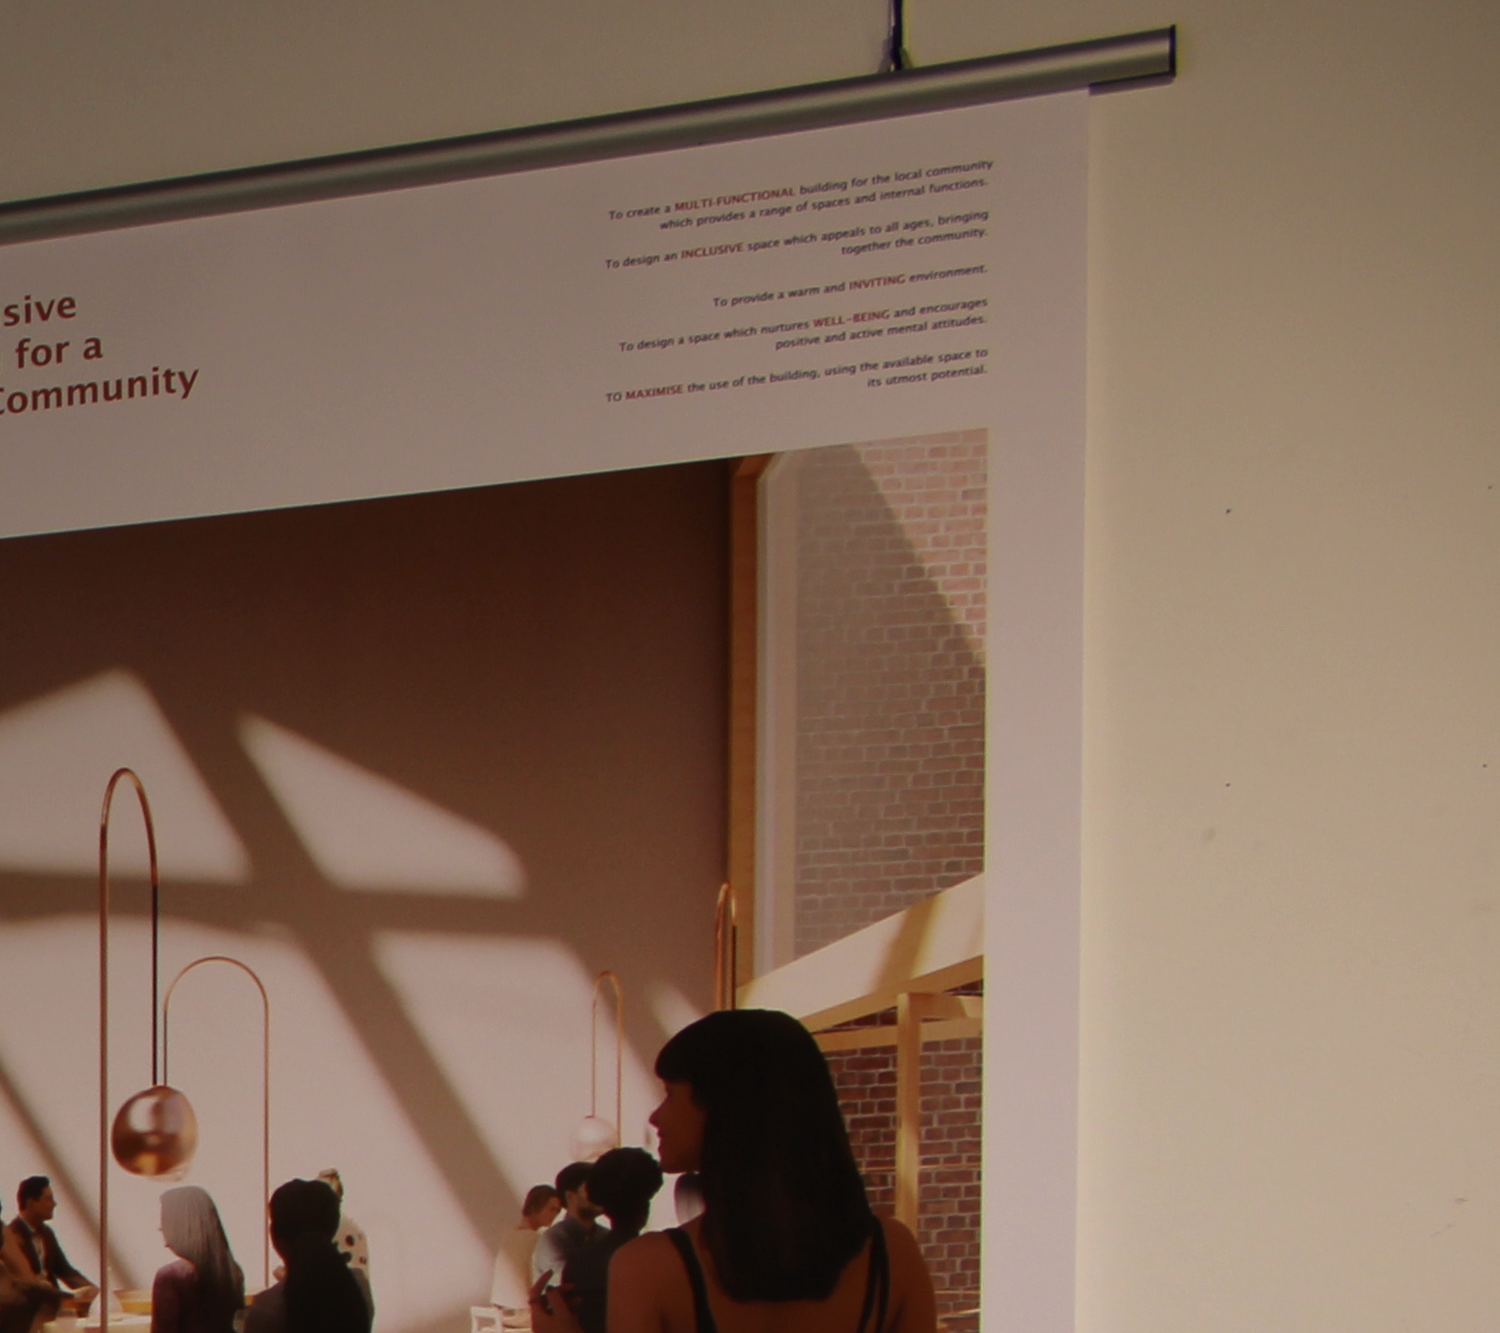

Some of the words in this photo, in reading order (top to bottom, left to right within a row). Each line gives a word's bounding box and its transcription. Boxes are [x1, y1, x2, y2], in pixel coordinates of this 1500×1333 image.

[609, 210, 623, 220] To
[627, 205, 660, 218] create
[665, 204, 671, 213] a
[675, 187, 795, 211] MULTI-FUNCTIONAL
[800, 179, 847, 195] building
[852, 176, 868, 188] for
[872, 173, 890, 185] the
[895, 168, 921, 182] local
[926, 160, 993, 178] community
[606, 259, 620, 269] To
[623, 252, 660, 268] design
[664, 252, 678, 261] an
[681, 242, 743, 259] INCLUSIVE
[747, 239, 780, 253] space
[784, 232, 817, 246] which
[821, 226, 865, 243] appeals
[869, 224, 881, 234] to
[886, 220, 898, 232] all
[902, 219, 933, 232] ages,
[938, 209, 989, 227] bringing
[841, 241, 890, 256] together
[895, 235, 914, 247] the
[918, 227, 988, 246] community.
[713, 297, 727, 307] To
[731, 290, 774, 307] provide
[778, 291, 784, 299] a
[788, 285, 820, 297] warm
[824, 282, 845, 293] and
[850, 274, 905, 291] INVITING
[909, 264, 988, 284] environment.
[776, 334, 820, 350] positive
[824, 331, 846, 344] and
[850, 326, 883, 340] active
[887, 321, 928, 335] mental
[932, 315, 987, 330] attitudes.
[16, 338, 70, 368] for
[83, 337, 103, 360] a
